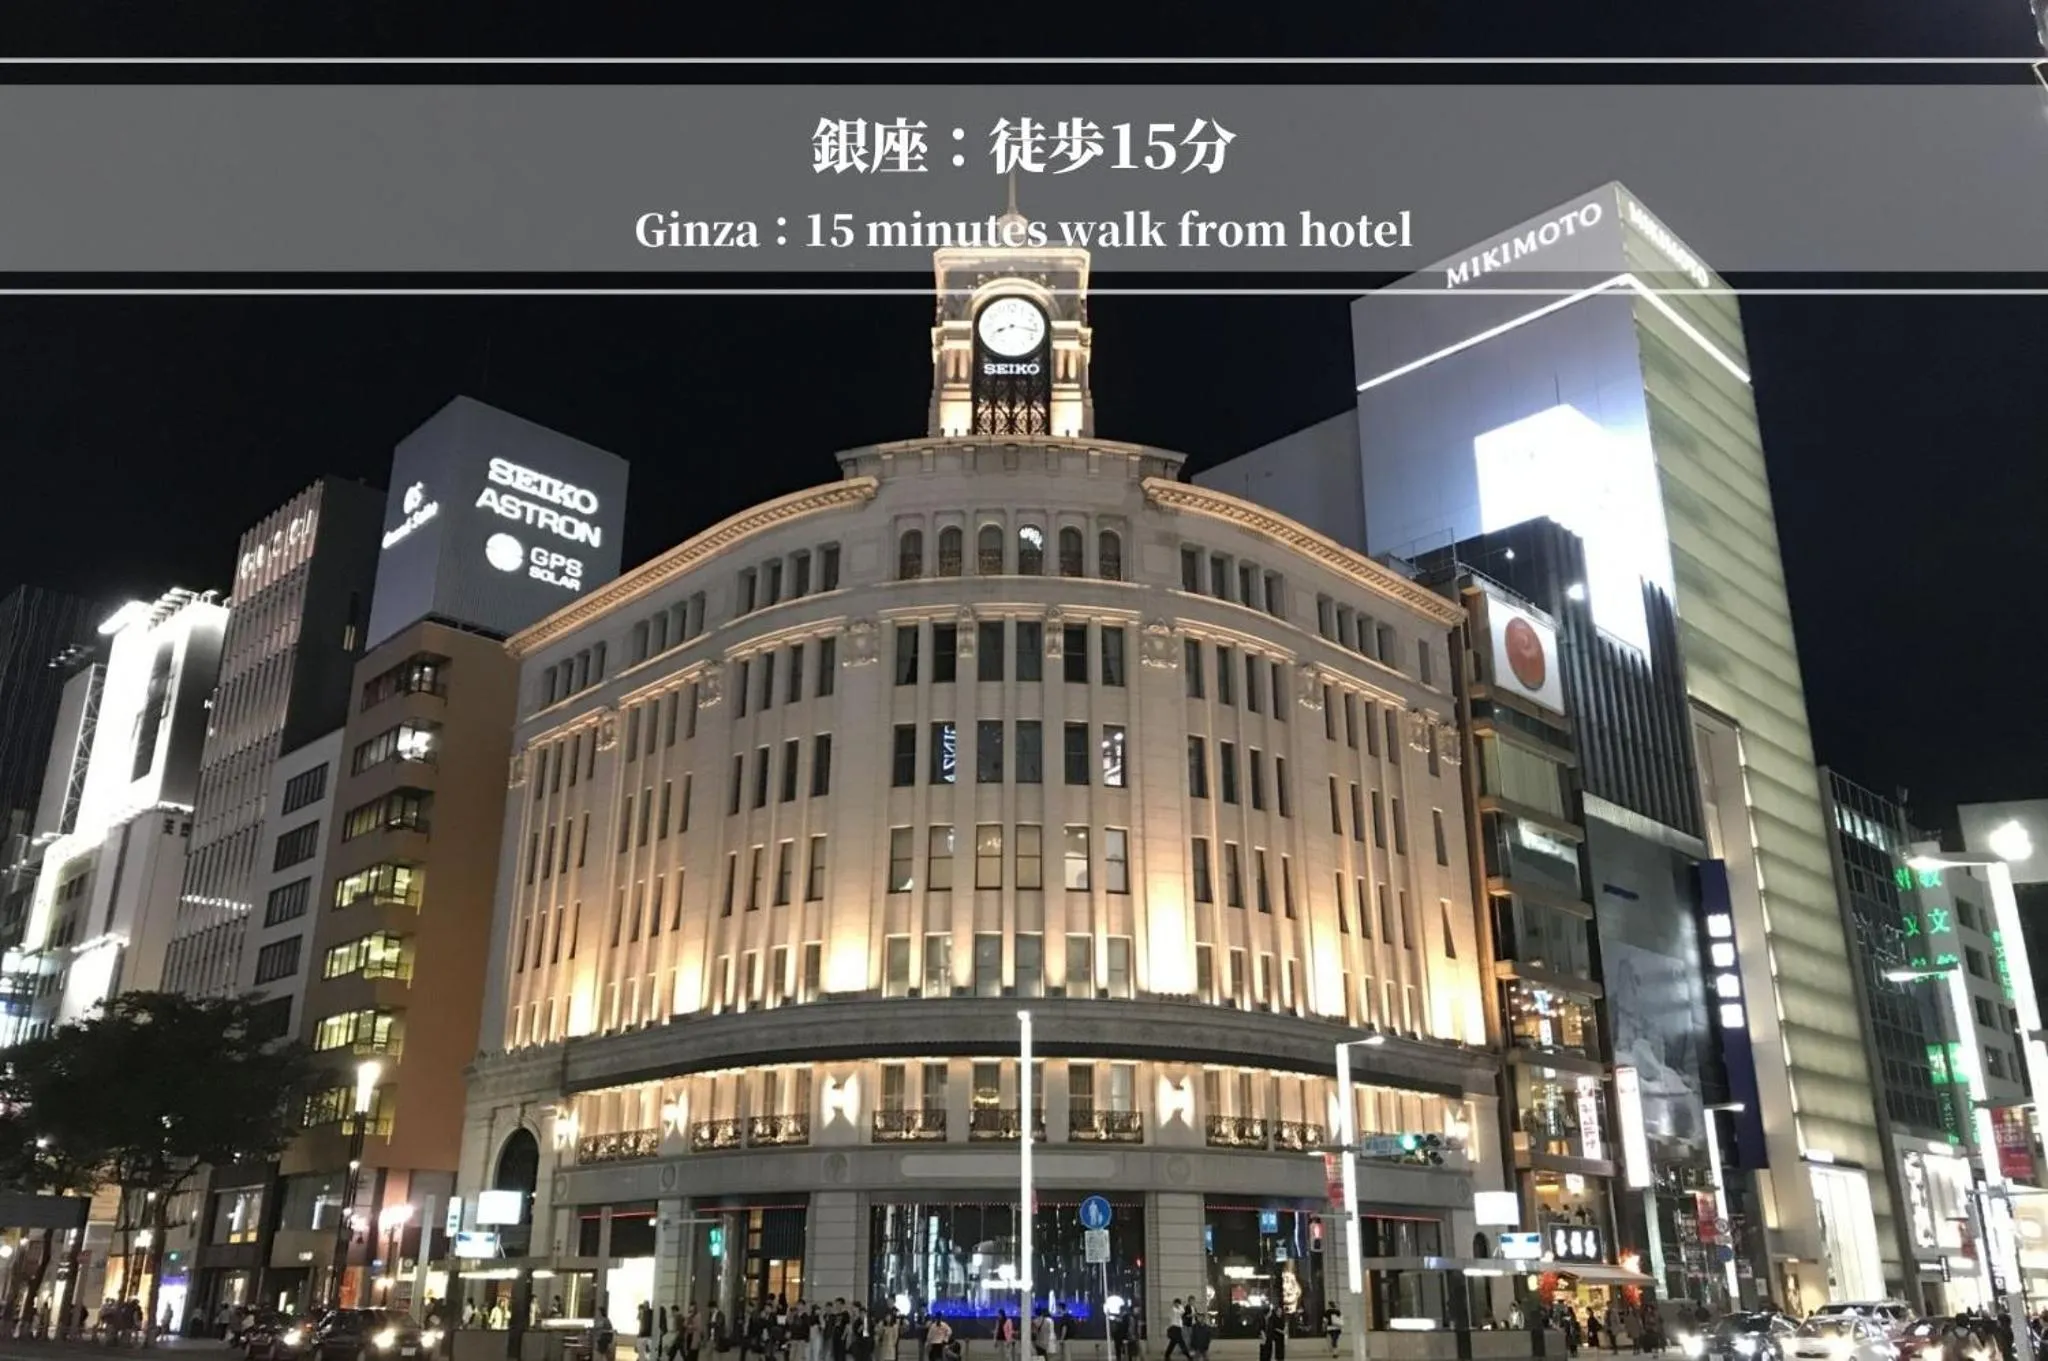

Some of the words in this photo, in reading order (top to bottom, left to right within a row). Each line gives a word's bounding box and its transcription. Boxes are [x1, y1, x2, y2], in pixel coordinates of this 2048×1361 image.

[1446, 202, 1603, 288] MIKIMOTO
[983, 363, 1040, 375] SEIKO
[488, 457, 599, 515] SEIKO
[475, 486, 602, 549] ASTRON
[528, 565, 582, 592] SOLAR
[529, 546, 584, 578] GPS
